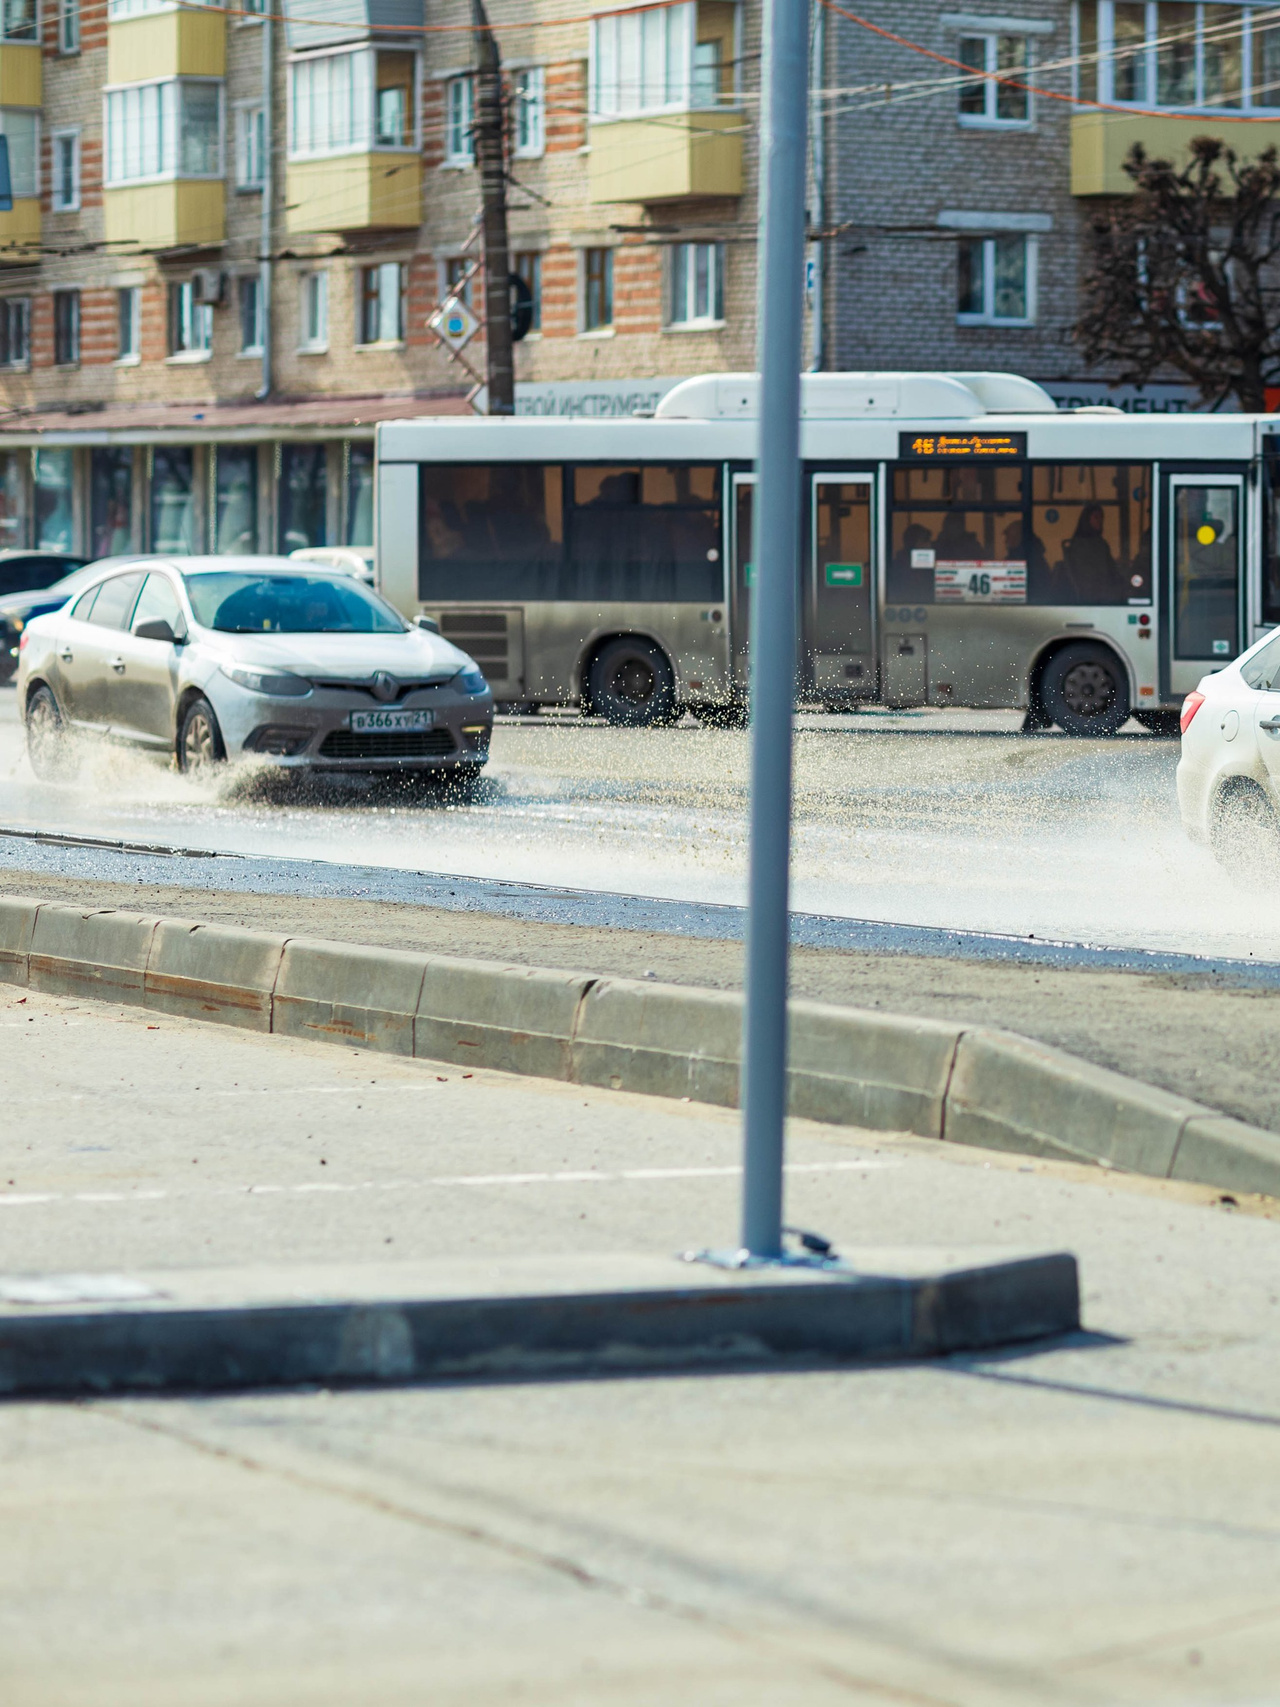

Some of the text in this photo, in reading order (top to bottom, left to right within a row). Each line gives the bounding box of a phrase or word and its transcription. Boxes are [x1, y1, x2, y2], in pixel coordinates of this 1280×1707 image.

[560, 391, 662, 416] ИНСТРУМЕНТ
[1052, 396, 1188, 414] ТРУМЕНТ
[968, 573, 991, 595] 46
